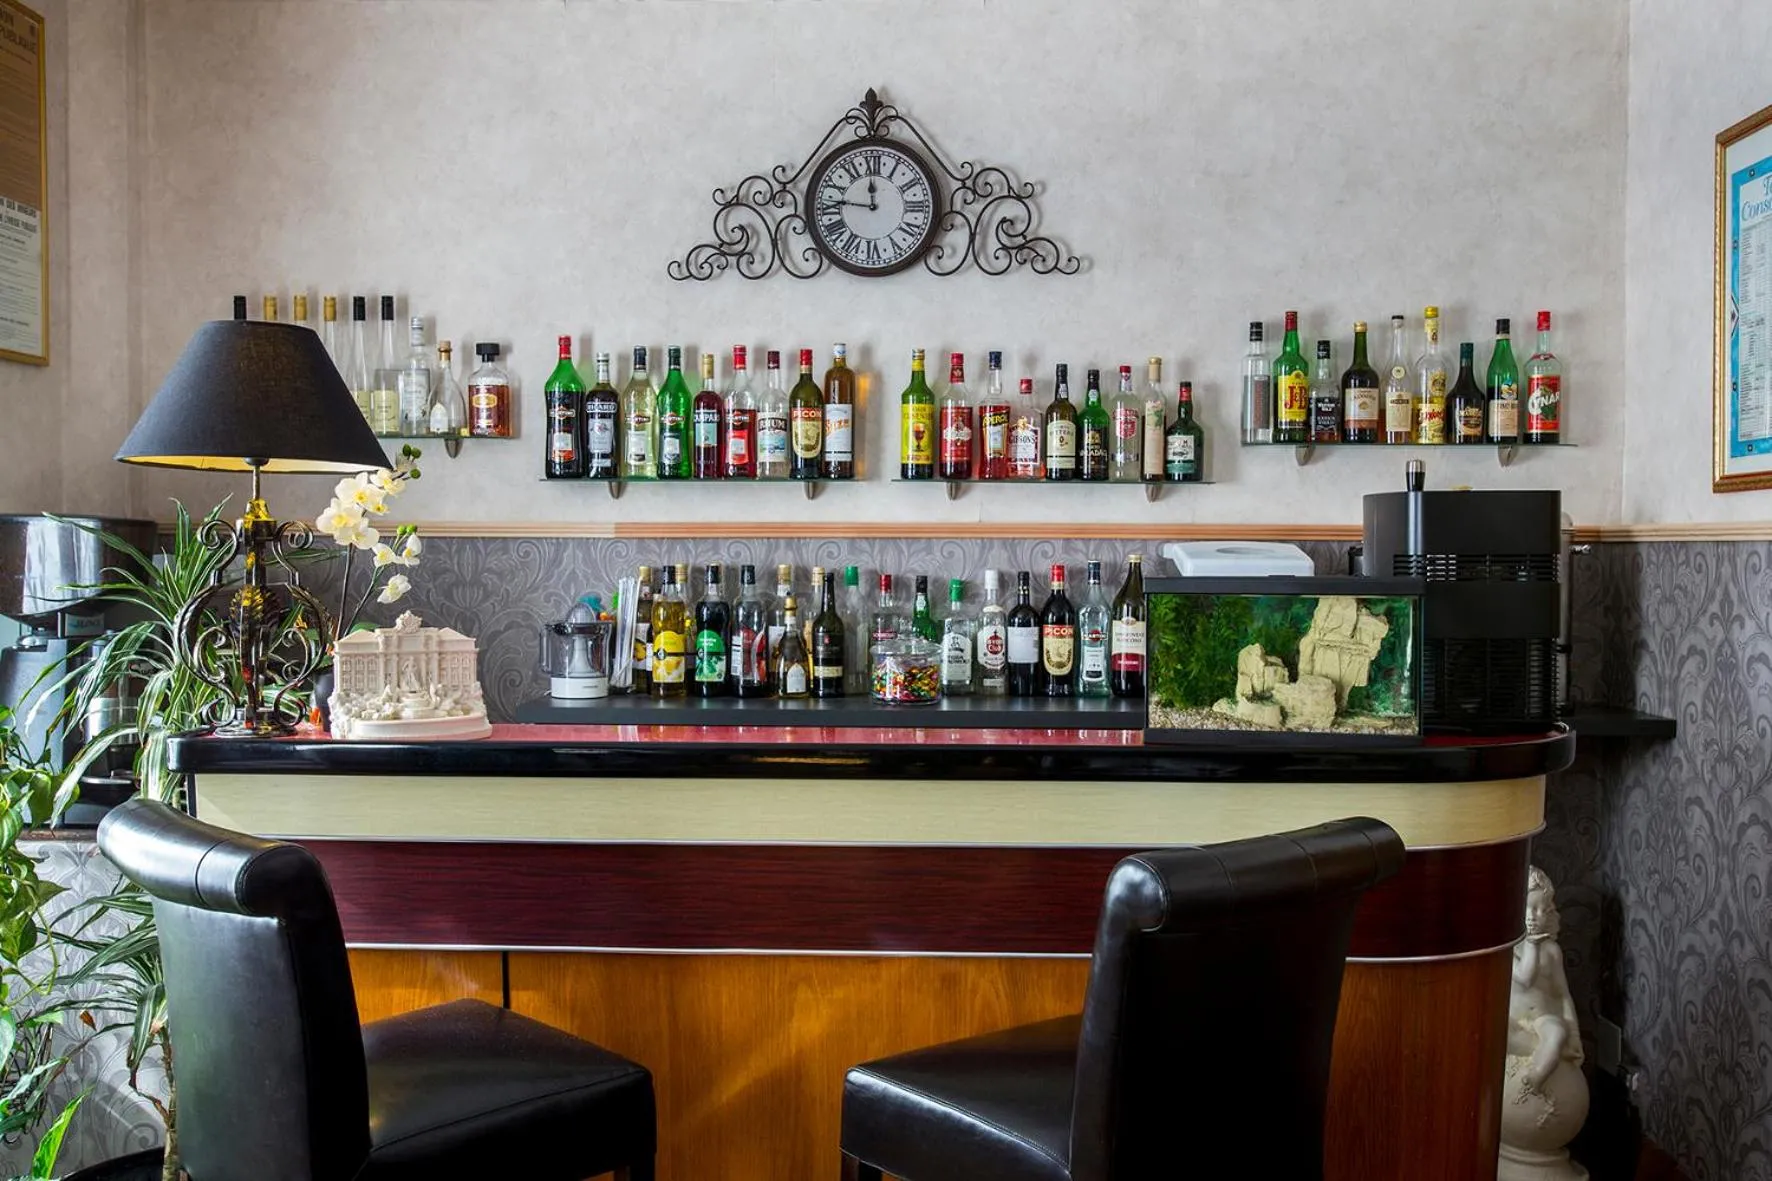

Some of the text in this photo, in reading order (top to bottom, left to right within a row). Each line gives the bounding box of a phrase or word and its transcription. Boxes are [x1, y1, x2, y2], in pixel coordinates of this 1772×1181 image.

[840, 160, 862, 182] XI
[864, 155, 882, 175] XII
[888, 162, 900, 180] I
[823, 177, 847, 193] X
[899, 178, 920, 193] II
[903, 200, 925, 213] III
[842, 233, 862, 255] VII
[866, 240, 882, 260] VI
[889, 236, 902, 255] V
[587, 403, 616, 411] RICARD
[1528, 387, 1560, 415] CYNAR
[793, 410, 822, 418] PICON
[758, 419, 786, 430] RHUM
